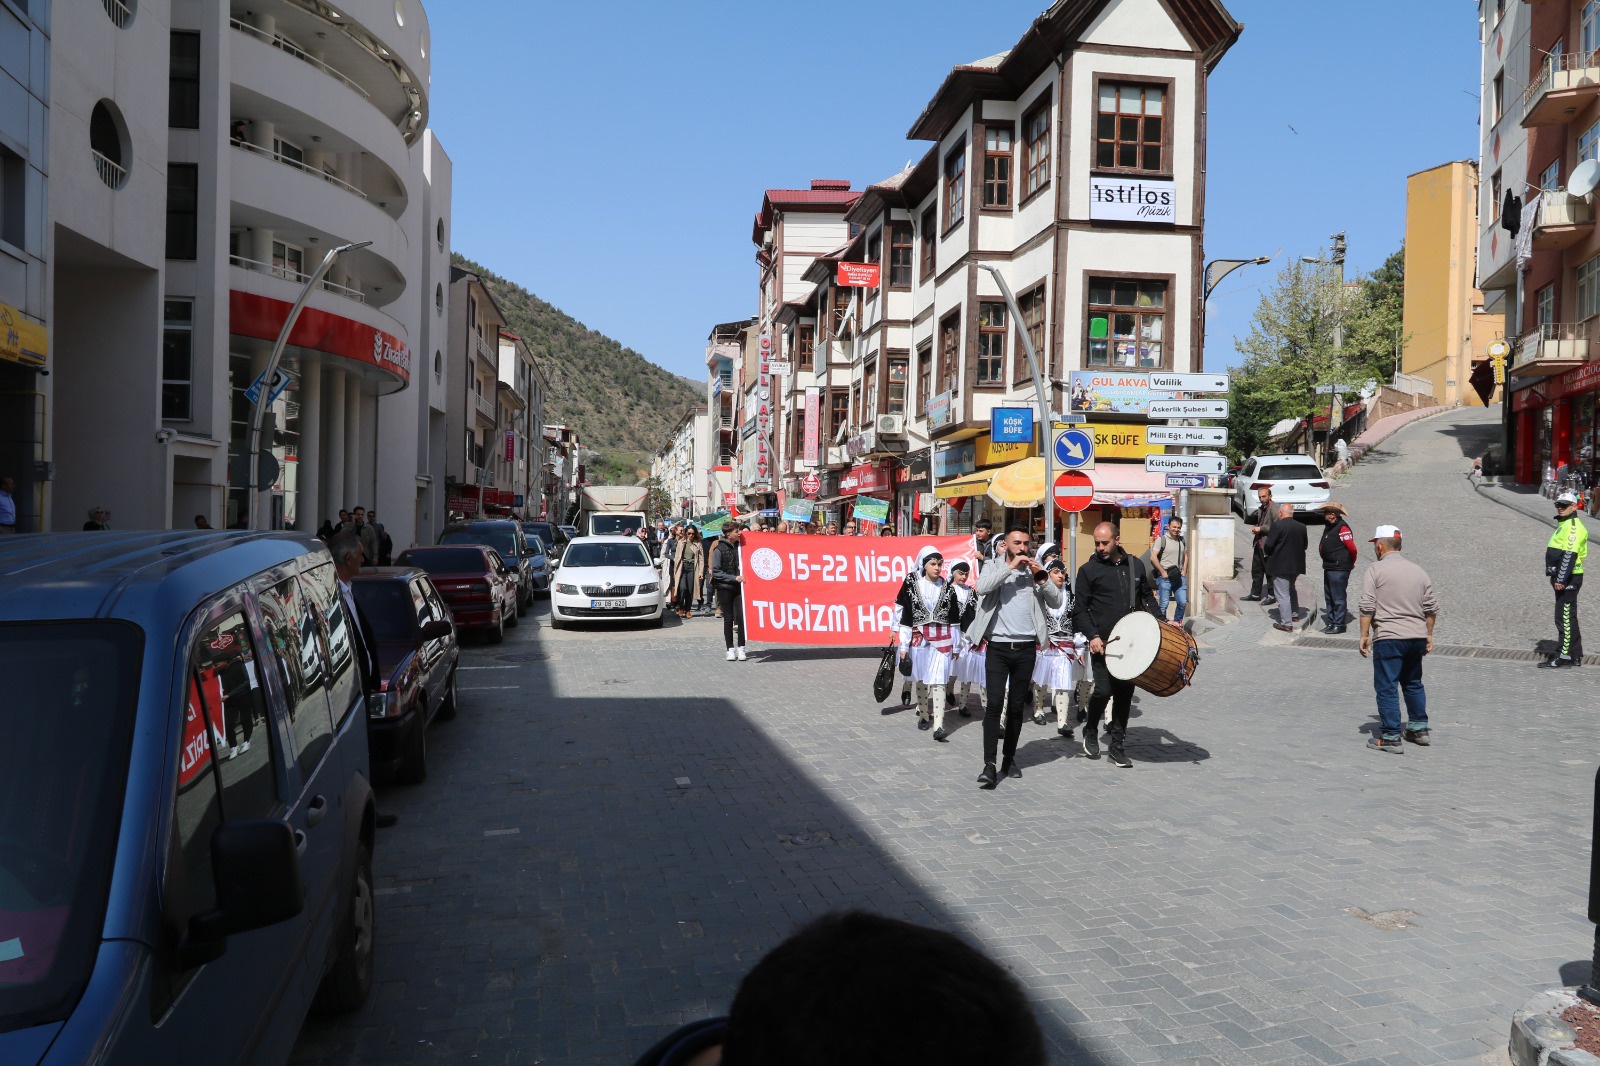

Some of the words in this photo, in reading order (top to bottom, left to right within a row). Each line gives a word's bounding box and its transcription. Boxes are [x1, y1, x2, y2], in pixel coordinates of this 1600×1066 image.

[1094, 184, 1170, 205] istilos
[1137, 205, 1171, 217] Müzik
[761, 338, 770, 386] OTEL
[1092, 375, 1114, 386] GÜL
[1117, 378, 1148, 387] AKVA
[1153, 378, 1182, 386] Valilik
[1183, 406, 1208, 414] Şubesi
[1003, 416, 1023, 426] KÖŞK
[1003, 425, 1023, 434] BÜFE
[757, 404, 769, 477] ATALAY
[1094, 433, 1109, 447] ŞK
[1111, 431, 1140, 446] BÜFE
[1168, 432, 1184, 441] Eğt.
[1149, 459, 1200, 468] Kütüphane
[789, 552, 848, 582] 15-22
[752, 597, 849, 632] TURİZM
[858, 604, 894, 633] HA
